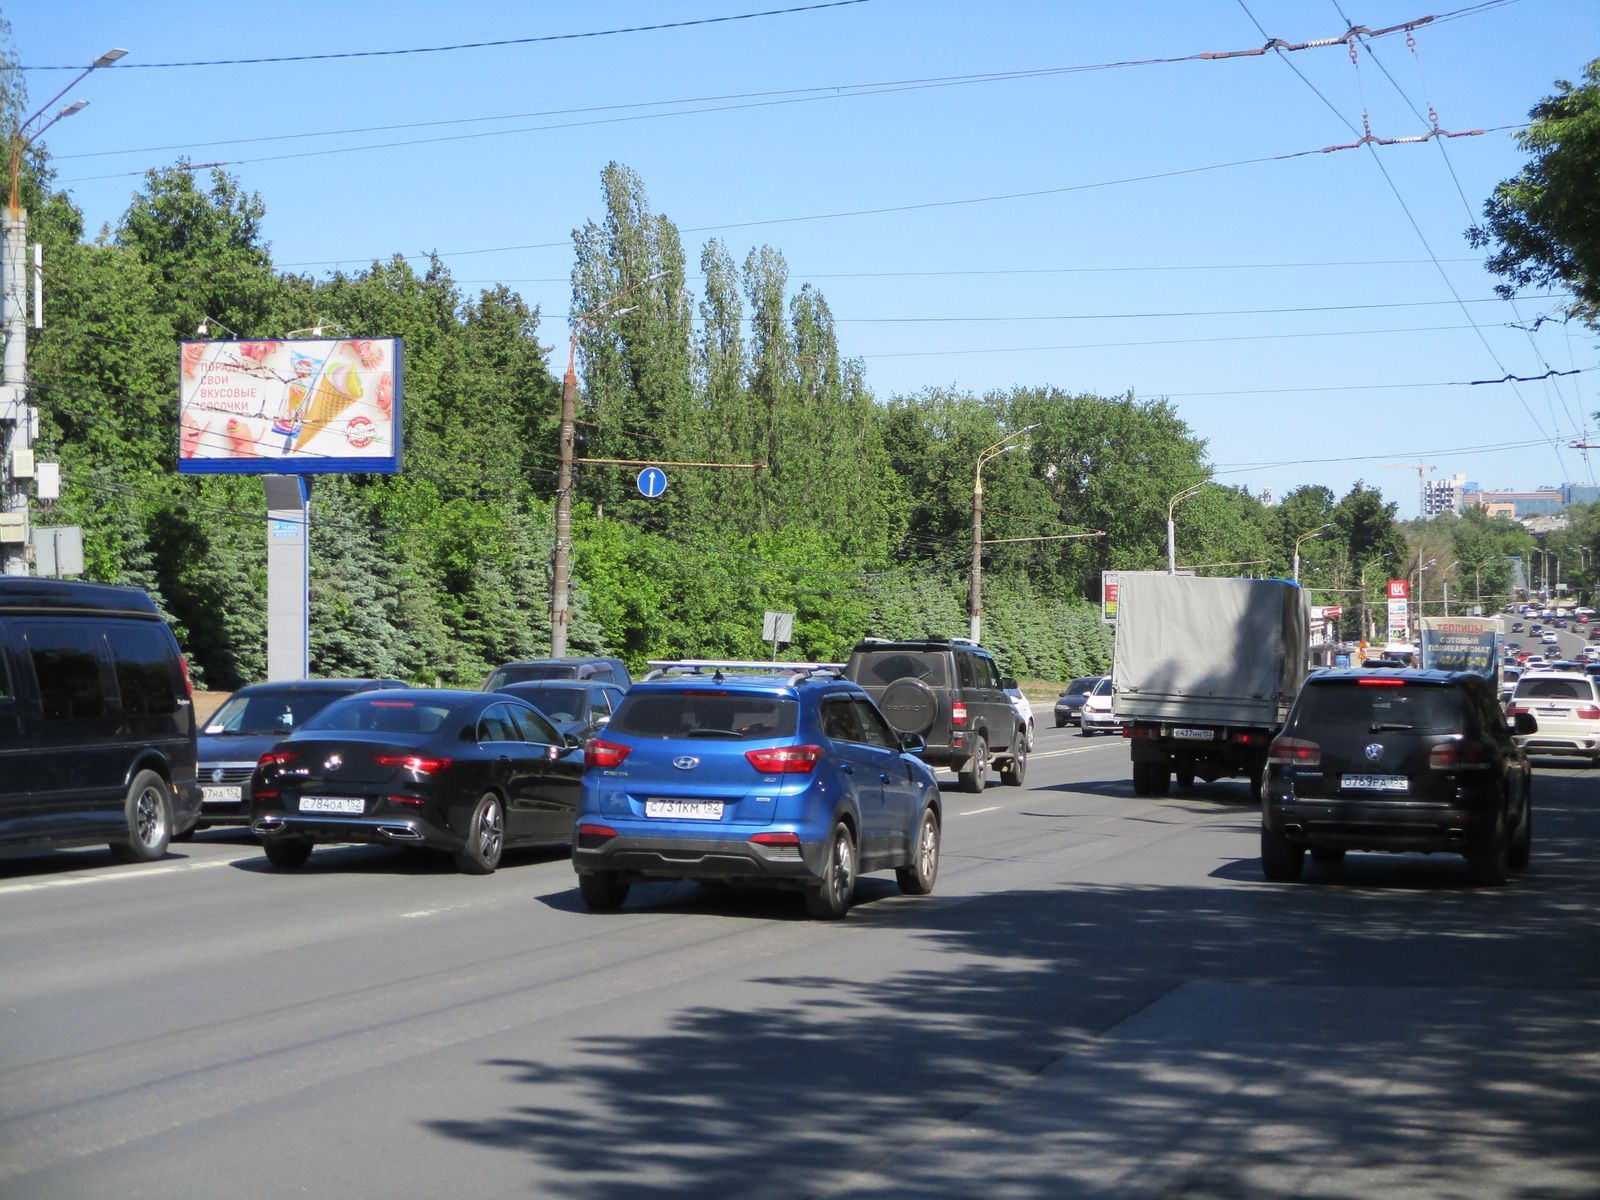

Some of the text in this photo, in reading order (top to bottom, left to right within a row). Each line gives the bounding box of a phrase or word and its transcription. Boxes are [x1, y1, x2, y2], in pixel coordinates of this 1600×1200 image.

[201, 375, 229, 385] СВОИ
[200, 388, 257, 398] ВКУСОВЫЕ
[200, 401, 248, 411] СОСОЧКИ
[1436, 623, 1484, 634] ТЕПЛИЦЫ
[1440, 636, 1479, 645] СОТОВЫЙ
[1428, 645, 1491, 654] ПОЛИКАРБОНАТ
[347, 799, 361, 808] 152
[702, 801, 721, 811] 152
